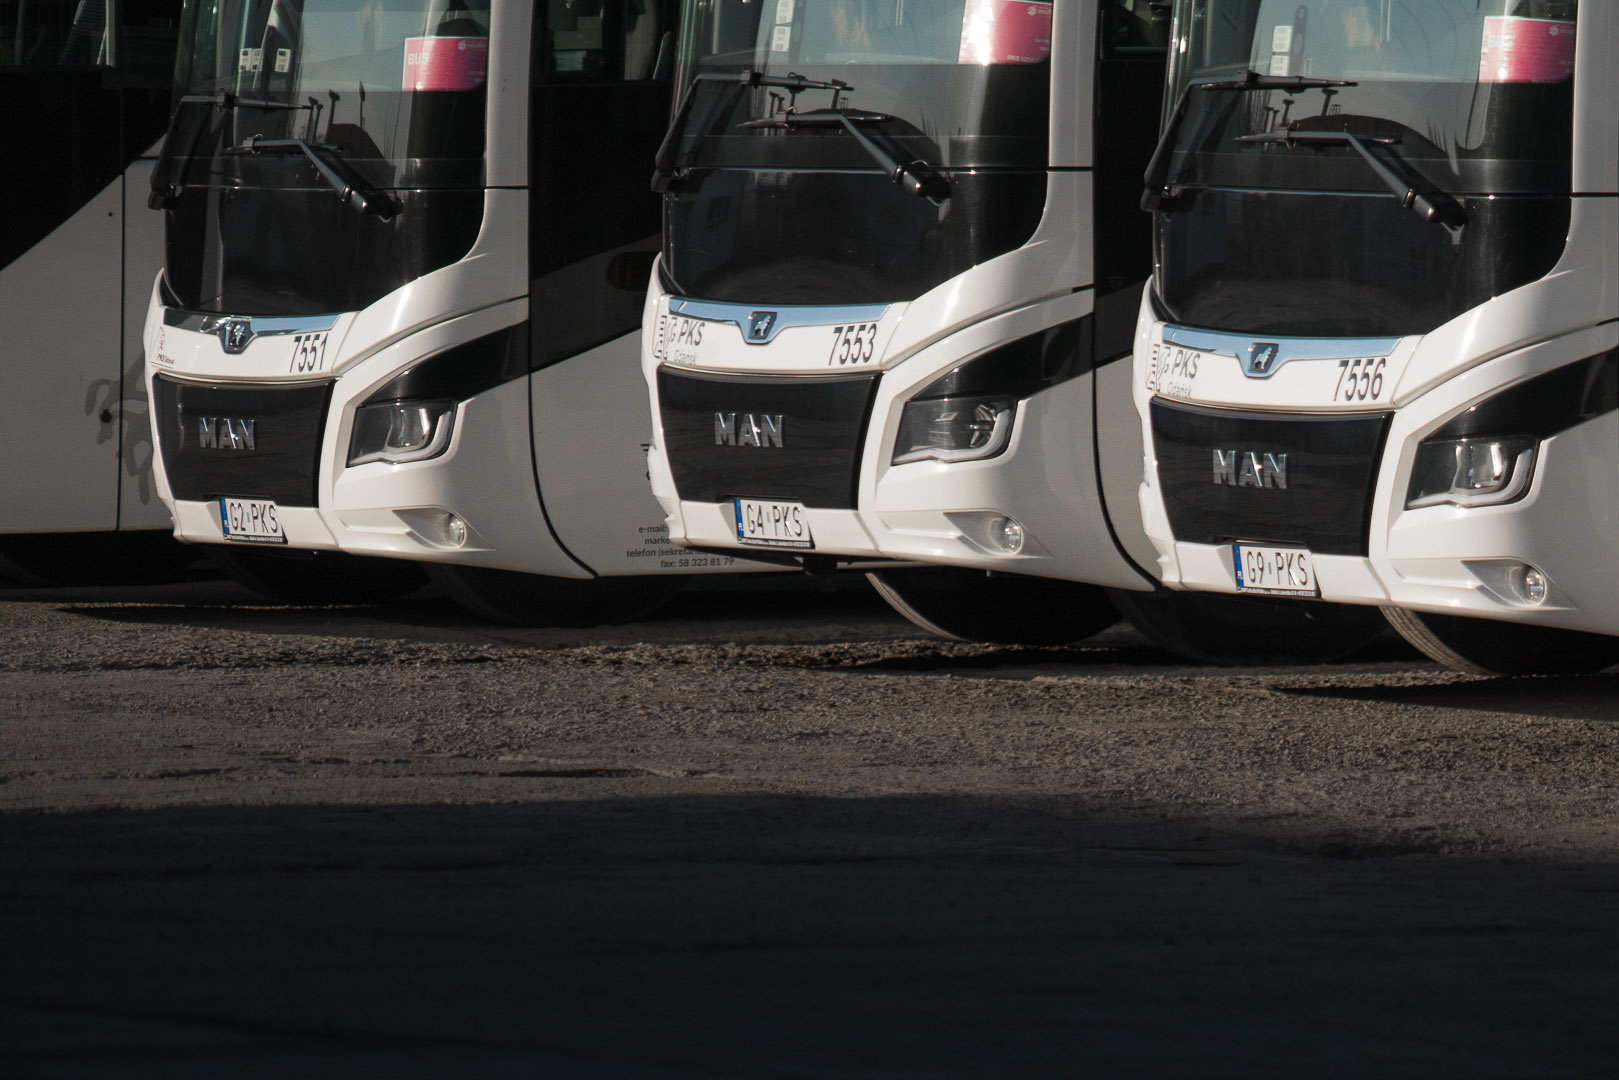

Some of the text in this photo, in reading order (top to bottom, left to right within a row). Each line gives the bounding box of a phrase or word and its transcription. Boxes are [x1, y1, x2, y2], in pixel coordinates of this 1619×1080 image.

[407, 52, 429, 65] BUS
[677, 319, 706, 347] PKS
[828, 323, 877, 366] 7553
[290, 332, 329, 373] 7551
[1171, 350, 1201, 379] PKS
[1333, 358, 1386, 402] 7556
[200, 417, 255, 450] MAN
[714, 412, 783, 448] MAN
[1212, 449, 1288, 489] MAN
[626, 548, 656, 558] telefon
[644, 536, 671, 545] marke
[660, 557, 735, 568] fax: 58 323 81 79
